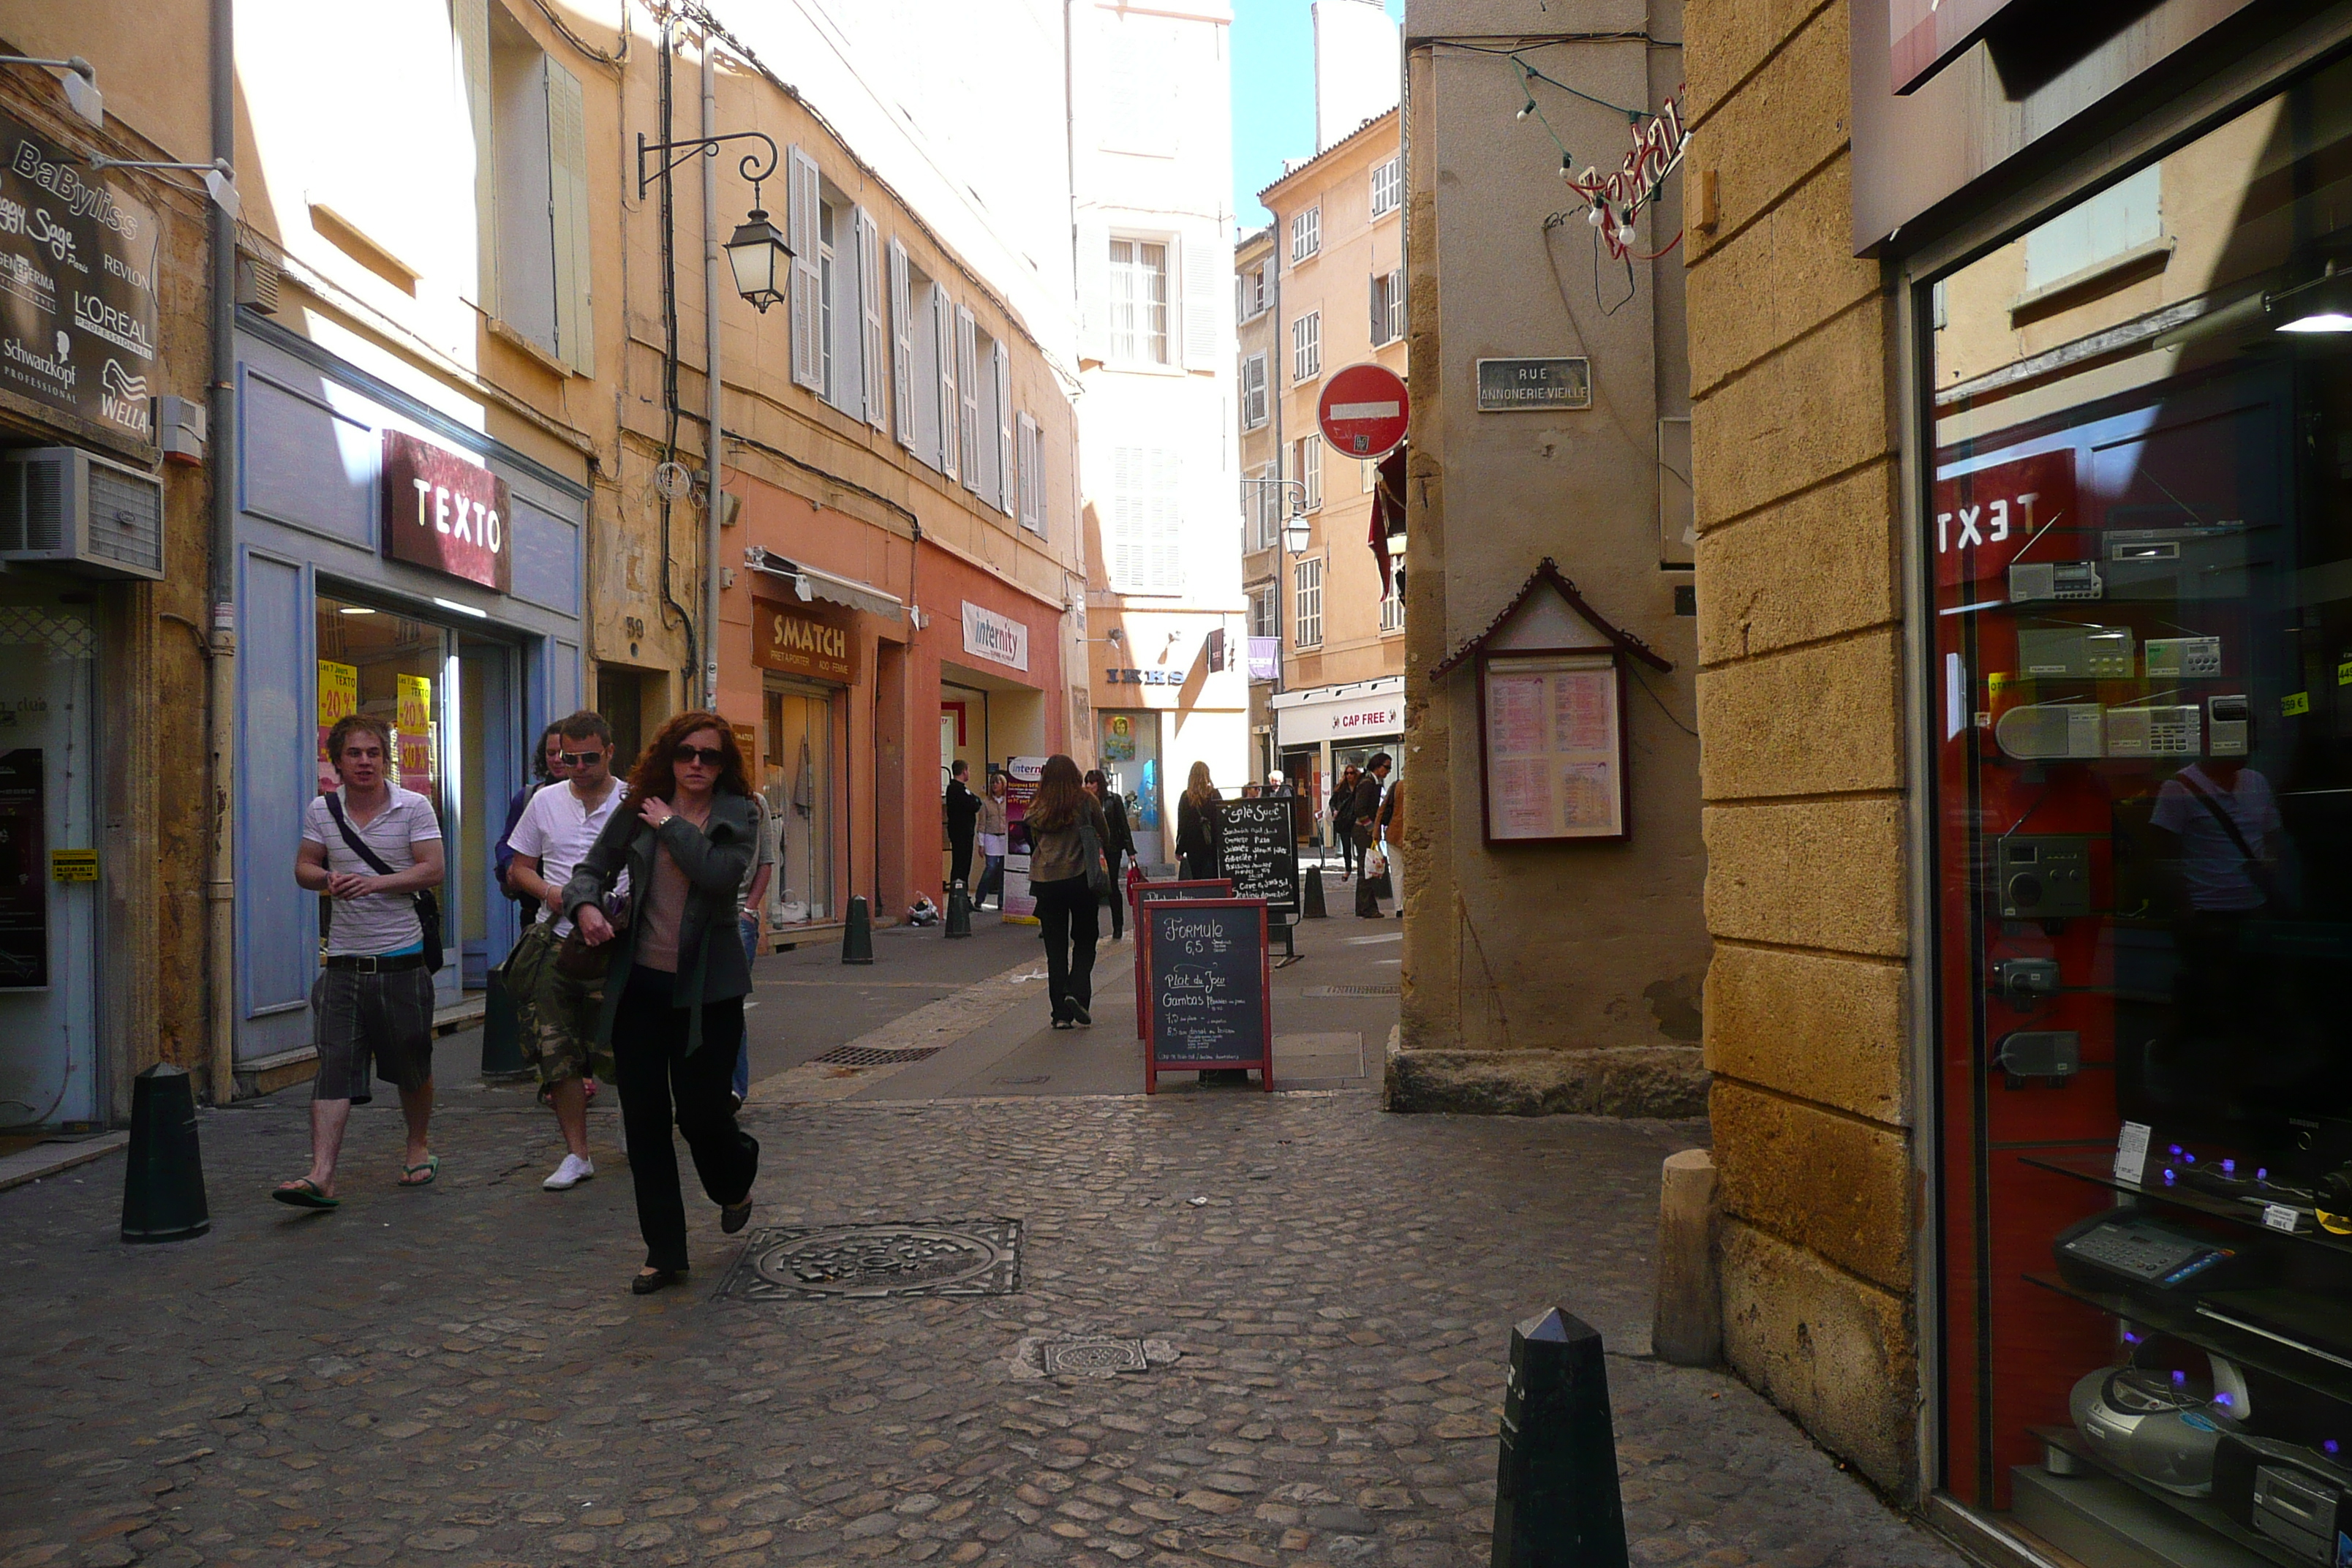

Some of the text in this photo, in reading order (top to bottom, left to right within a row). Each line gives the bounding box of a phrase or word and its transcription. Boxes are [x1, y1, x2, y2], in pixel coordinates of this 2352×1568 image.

[12, 140, 138, 241] BaByliss
[0, 197, 77, 261] ggy Sage
[67, 253, 89, 274] Paris
[104, 254, 151, 293] REVLON
[75, 291, 152, 348] L'ORÉAL
[76, 317, 152, 359] PROFESSIONNEL
[4, 339, 76, 390] Schwarzkopf
[1519, 368, 1548, 380] RUE
[4, 366, 77, 404] PROFESSIONAL
[102, 393, 147, 434] WELLA
[413, 478, 502, 554] TEXTO
[774, 614, 845, 659] SMATCH
[975, 611, 1018, 662] internity
[320, 662, 328, 671] Les
[335, 666, 348, 675] Jours
[335, 674, 356, 688] TEXTO
[1107, 668, 1186, 687] IKKS
[320, 689, 341, 718] -20
[411, 687, 429, 698] TEXTO
[2281, 698, 2304, 711] 259 €
[399, 701, 416, 728] -20
[1342, 712, 1385, 728] CAP FREE
[400, 742, 415, 768] -30
[1012, 763, 1041, 773] intern
[1164, 973, 1190, 988] Plat
[1194, 973, 1203, 985] du
[1163, 992, 1205, 1008] Gambas
